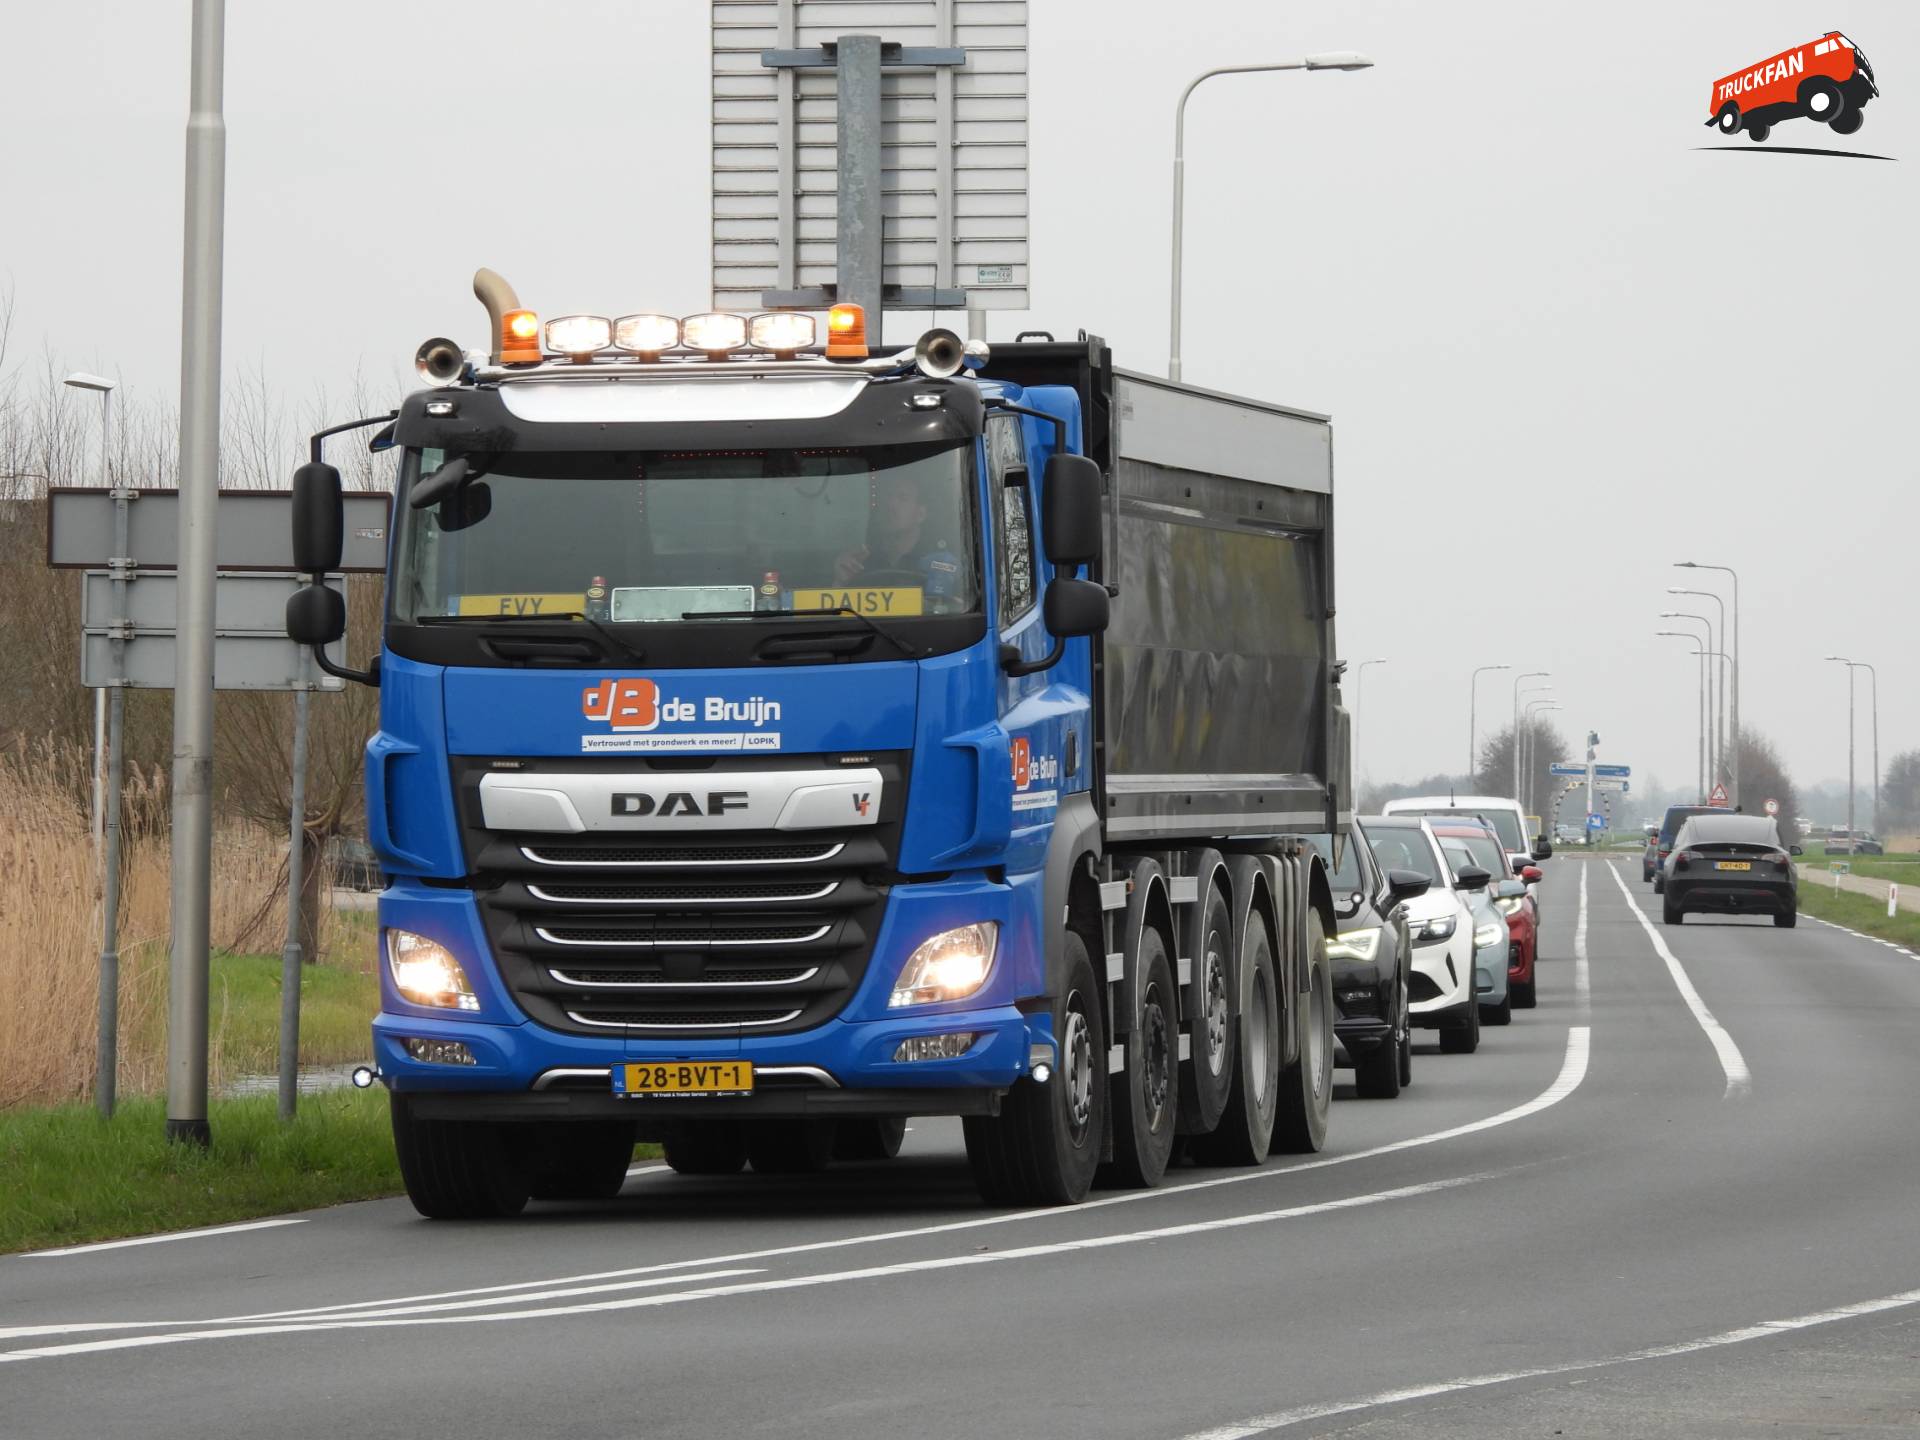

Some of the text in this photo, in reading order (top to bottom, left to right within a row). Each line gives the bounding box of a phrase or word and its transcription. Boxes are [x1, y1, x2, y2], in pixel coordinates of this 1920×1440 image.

[820, 591, 894, 613] DAISY
[662, 697, 781, 727] de Bruijn
[633, 739, 650, 747] met
[651, 738, 697, 748] grondwerk
[748, 737, 776, 745] LOPIK
[611, 791, 749, 817] DAF
[638, 1066, 740, 1088] 28-BVT-1
